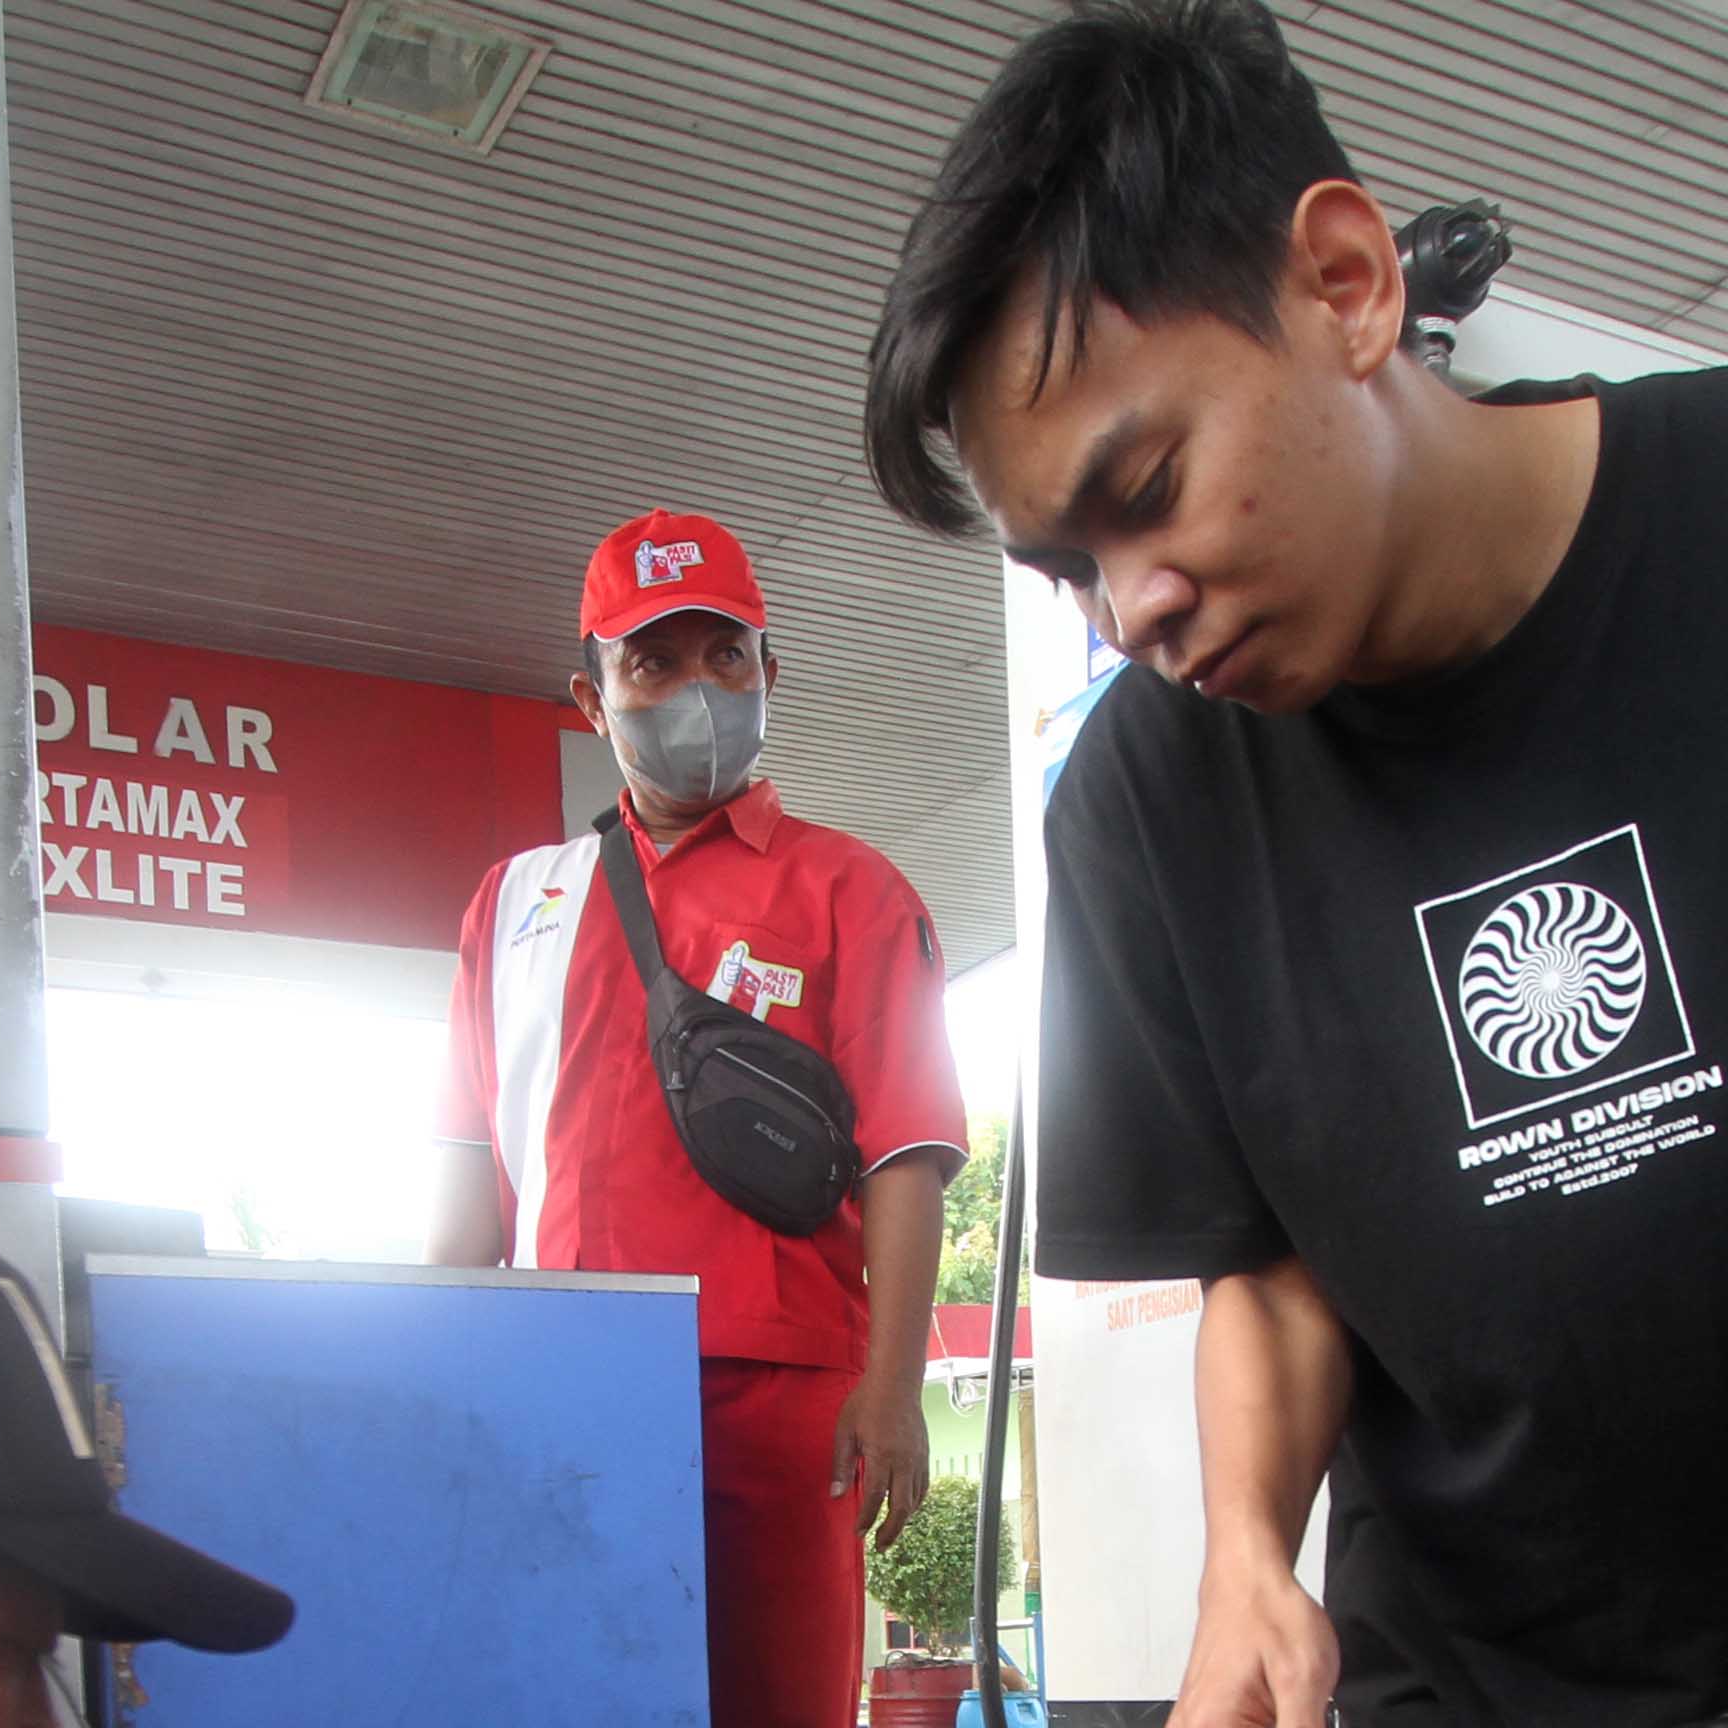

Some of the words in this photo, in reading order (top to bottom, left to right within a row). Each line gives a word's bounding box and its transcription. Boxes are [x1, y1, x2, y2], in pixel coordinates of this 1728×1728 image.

[33, 674, 278, 773] OLAR
[41, 842, 246, 916] XLITE
[1457, 1118, 1564, 1170] ROWN
[1571, 1065, 1723, 1133] DIVISION
[1493, 1158, 1568, 1189] CONTINUE
[1570, 1147, 1602, 1164] THE
[1604, 1115, 1699, 1154] DOMINATION
[1529, 1138, 1582, 1162] YOUTH
[1584, 1115, 1654, 1146] SUBCULT
[1483, 1185, 1526, 1206] BUILD
[1528, 1177, 1550, 1192] TO
[1554, 1154, 1619, 1184] AGAINST
[1624, 1142, 1656, 1161] THE
[1658, 1124, 1716, 1151] WORLD
[1107, 1296, 1134, 1331] SAAT
[1138, 1280, 1202, 1325] PENGISIAN
